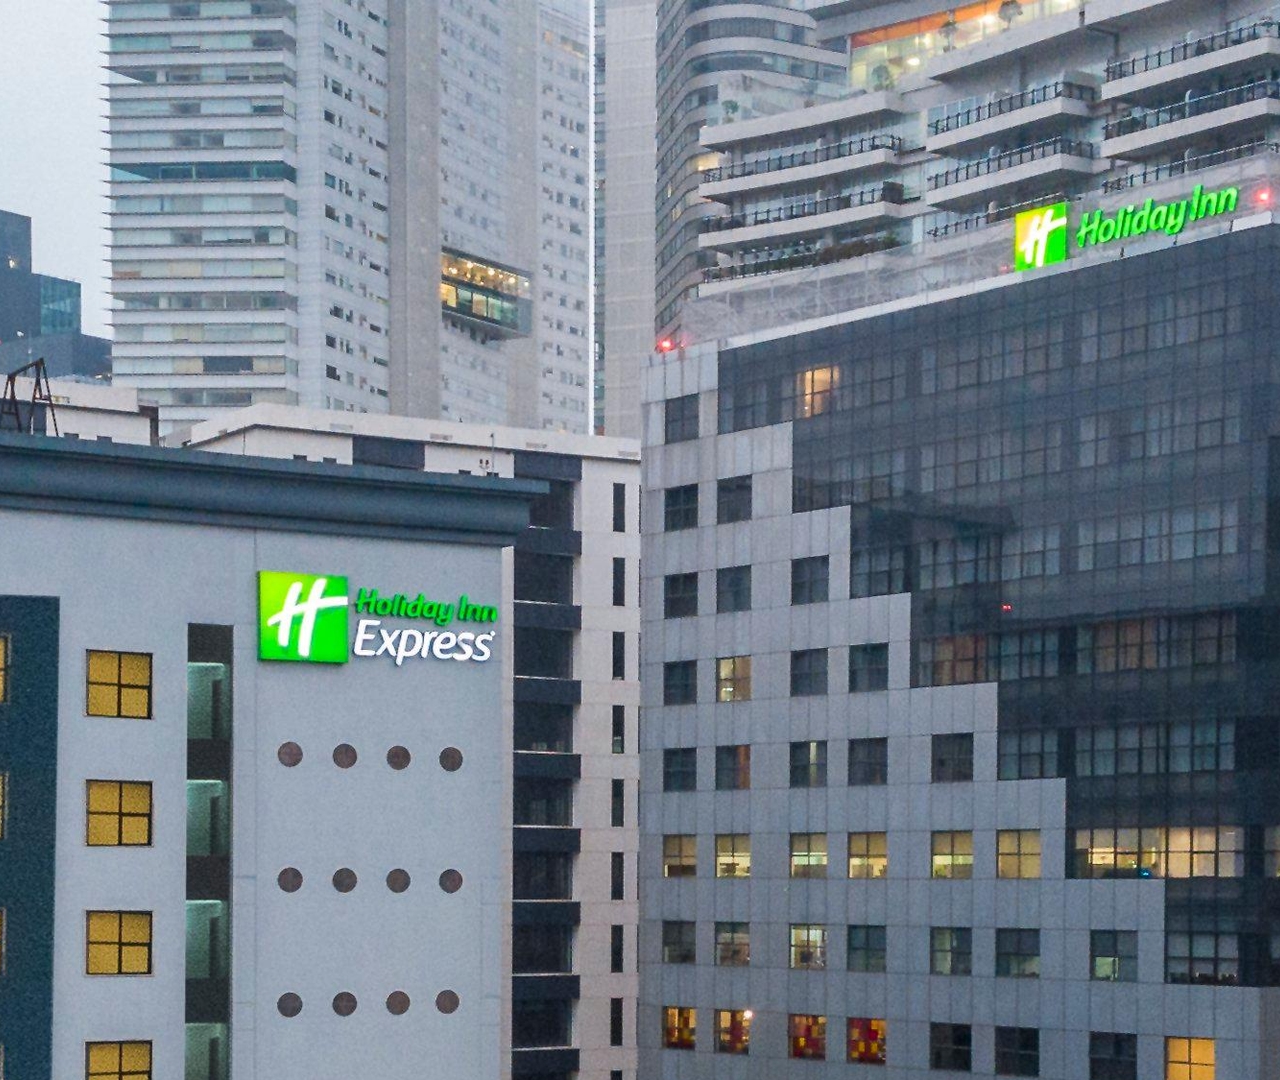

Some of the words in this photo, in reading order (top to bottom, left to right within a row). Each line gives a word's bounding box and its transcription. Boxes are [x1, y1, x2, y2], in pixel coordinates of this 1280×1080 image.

[1076, 196, 1188, 248] Holiday
[1187, 183, 1239, 222] Inn
[355, 586, 454, 627] Holiday
[458, 593, 498, 623] Inn
[353, 618, 496, 667] Express
